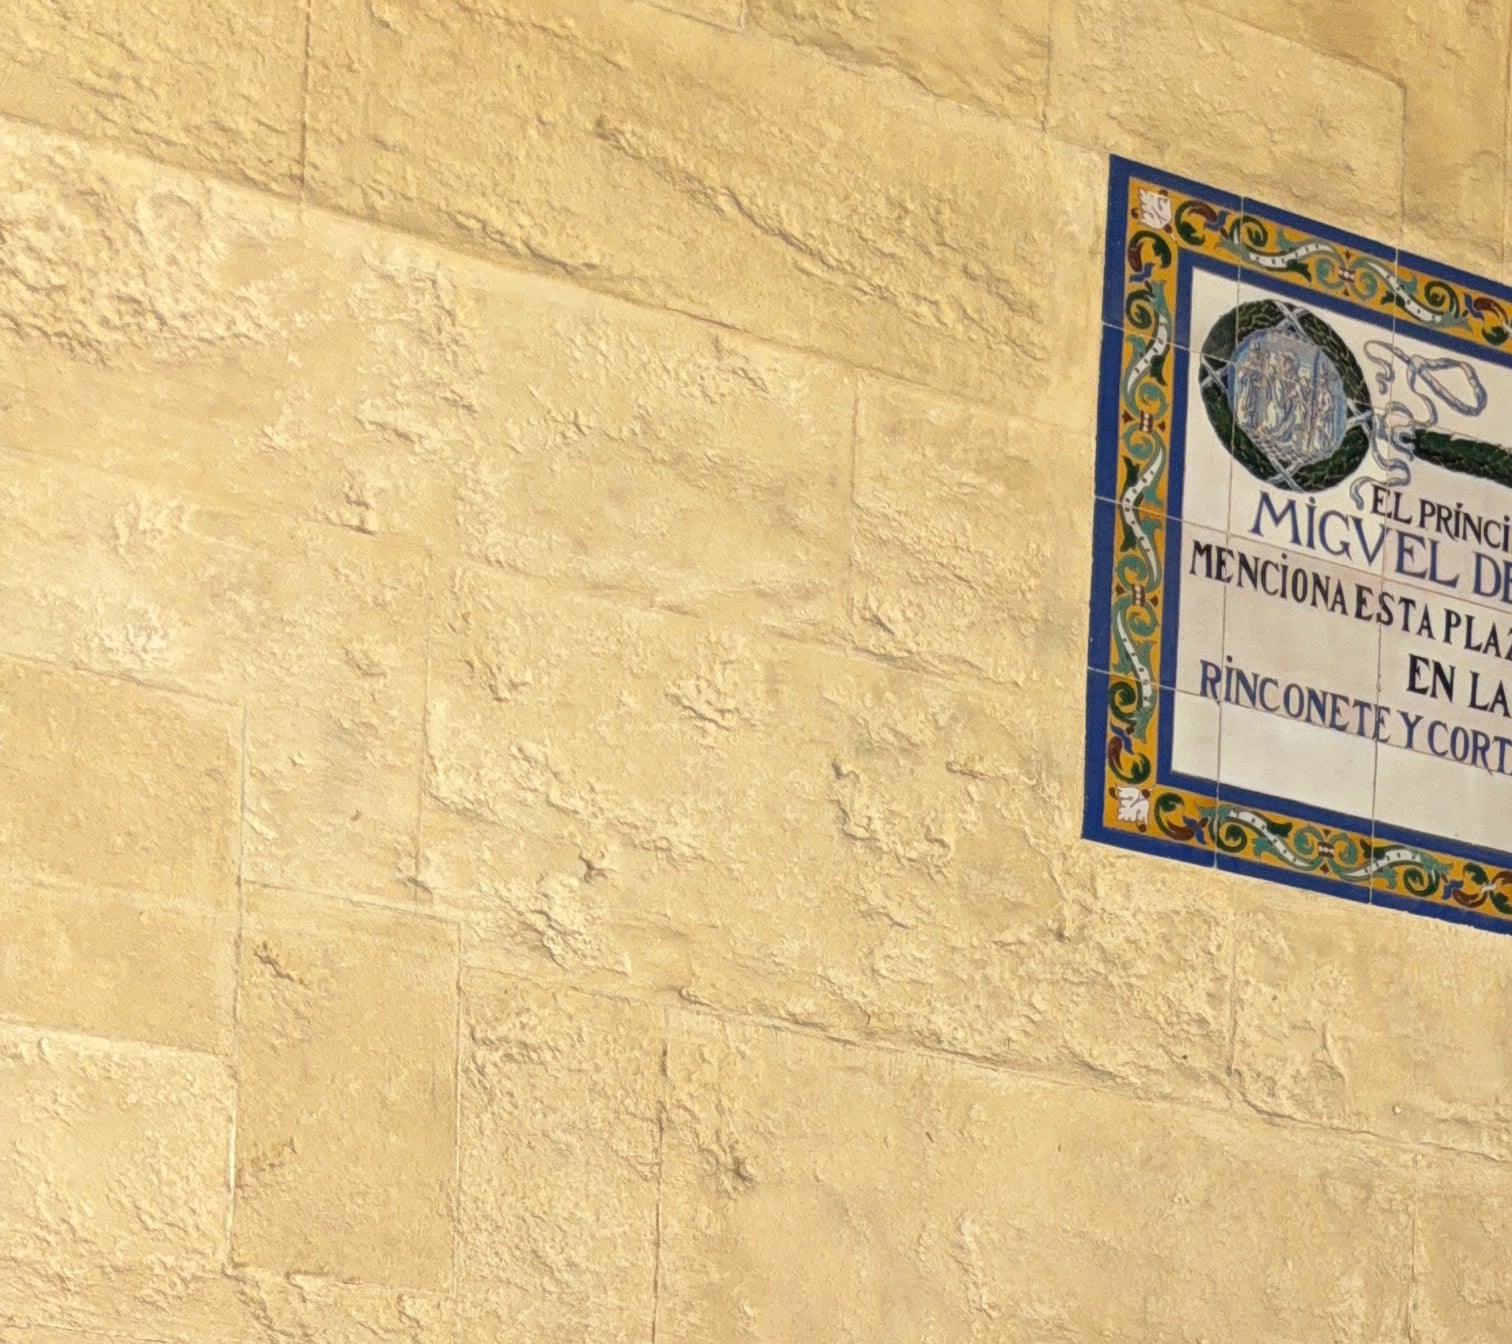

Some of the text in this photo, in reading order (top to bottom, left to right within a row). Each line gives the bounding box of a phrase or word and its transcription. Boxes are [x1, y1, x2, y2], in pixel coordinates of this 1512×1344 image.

[1248, 491, 1460, 588] MIGVEL
[1370, 484, 1413, 524] EL
[1188, 539, 1348, 616] MENCIONA
[1355, 583, 1436, 640] ESTA
[1199, 654, 1392, 743] RINCONETE
[1396, 709, 1424, 749] Y
[1406, 653, 1456, 703] EN
